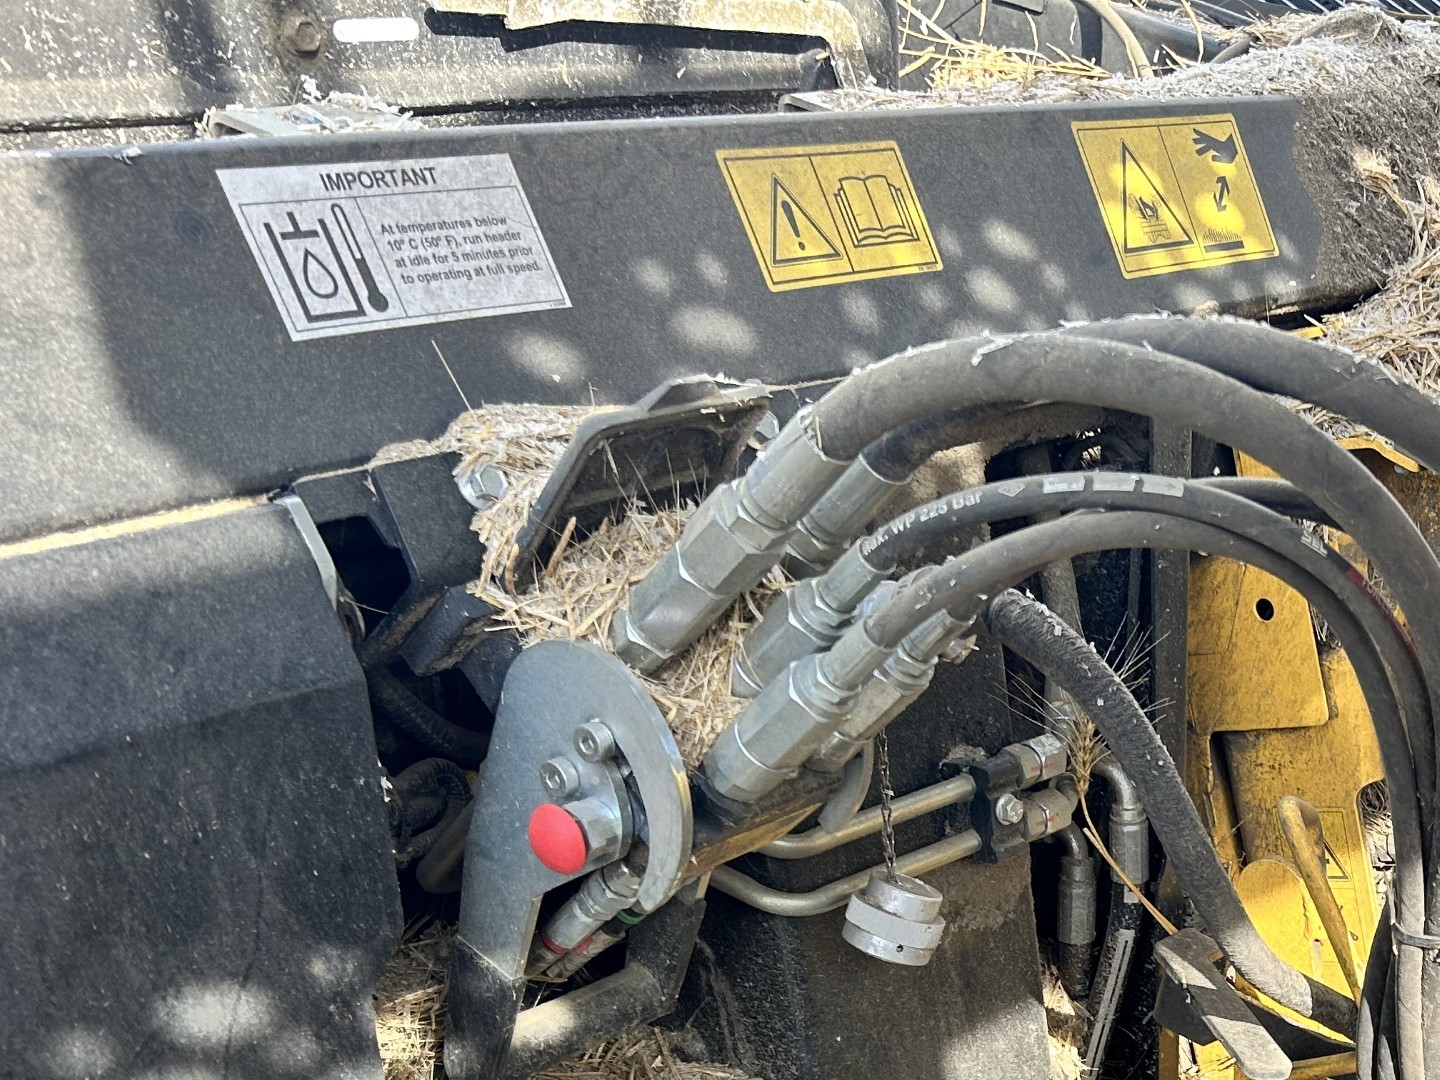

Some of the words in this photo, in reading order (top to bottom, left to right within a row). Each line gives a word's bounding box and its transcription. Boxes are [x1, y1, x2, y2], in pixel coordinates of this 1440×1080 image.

[320, 167, 438, 192] IMPORTANT
[381, 223, 395, 236] At
[396, 219, 472, 237] temperatures
[473, 216, 507, 228] below
[409, 238, 419, 250] C
[445, 235, 463, 249] F),
[463, 235, 483, 246] run
[485, 231, 521, 243] header
[394, 256, 407, 269] at
[408, 254, 430, 267] idle
[432, 252, 449, 264] for
[452, 250, 460, 263] 5
[462, 248, 506, 262] minutes
[508, 246, 534, 259] prior
[401, 273, 415, 285] to
[417, 268, 473, 285] operating
[474, 266, 486, 277] at
[486, 264, 505, 276] full
[507, 261, 543, 275] speed.
[890, 513, 915, 535] WP
[1301, 529, 1328, 557] SEL
